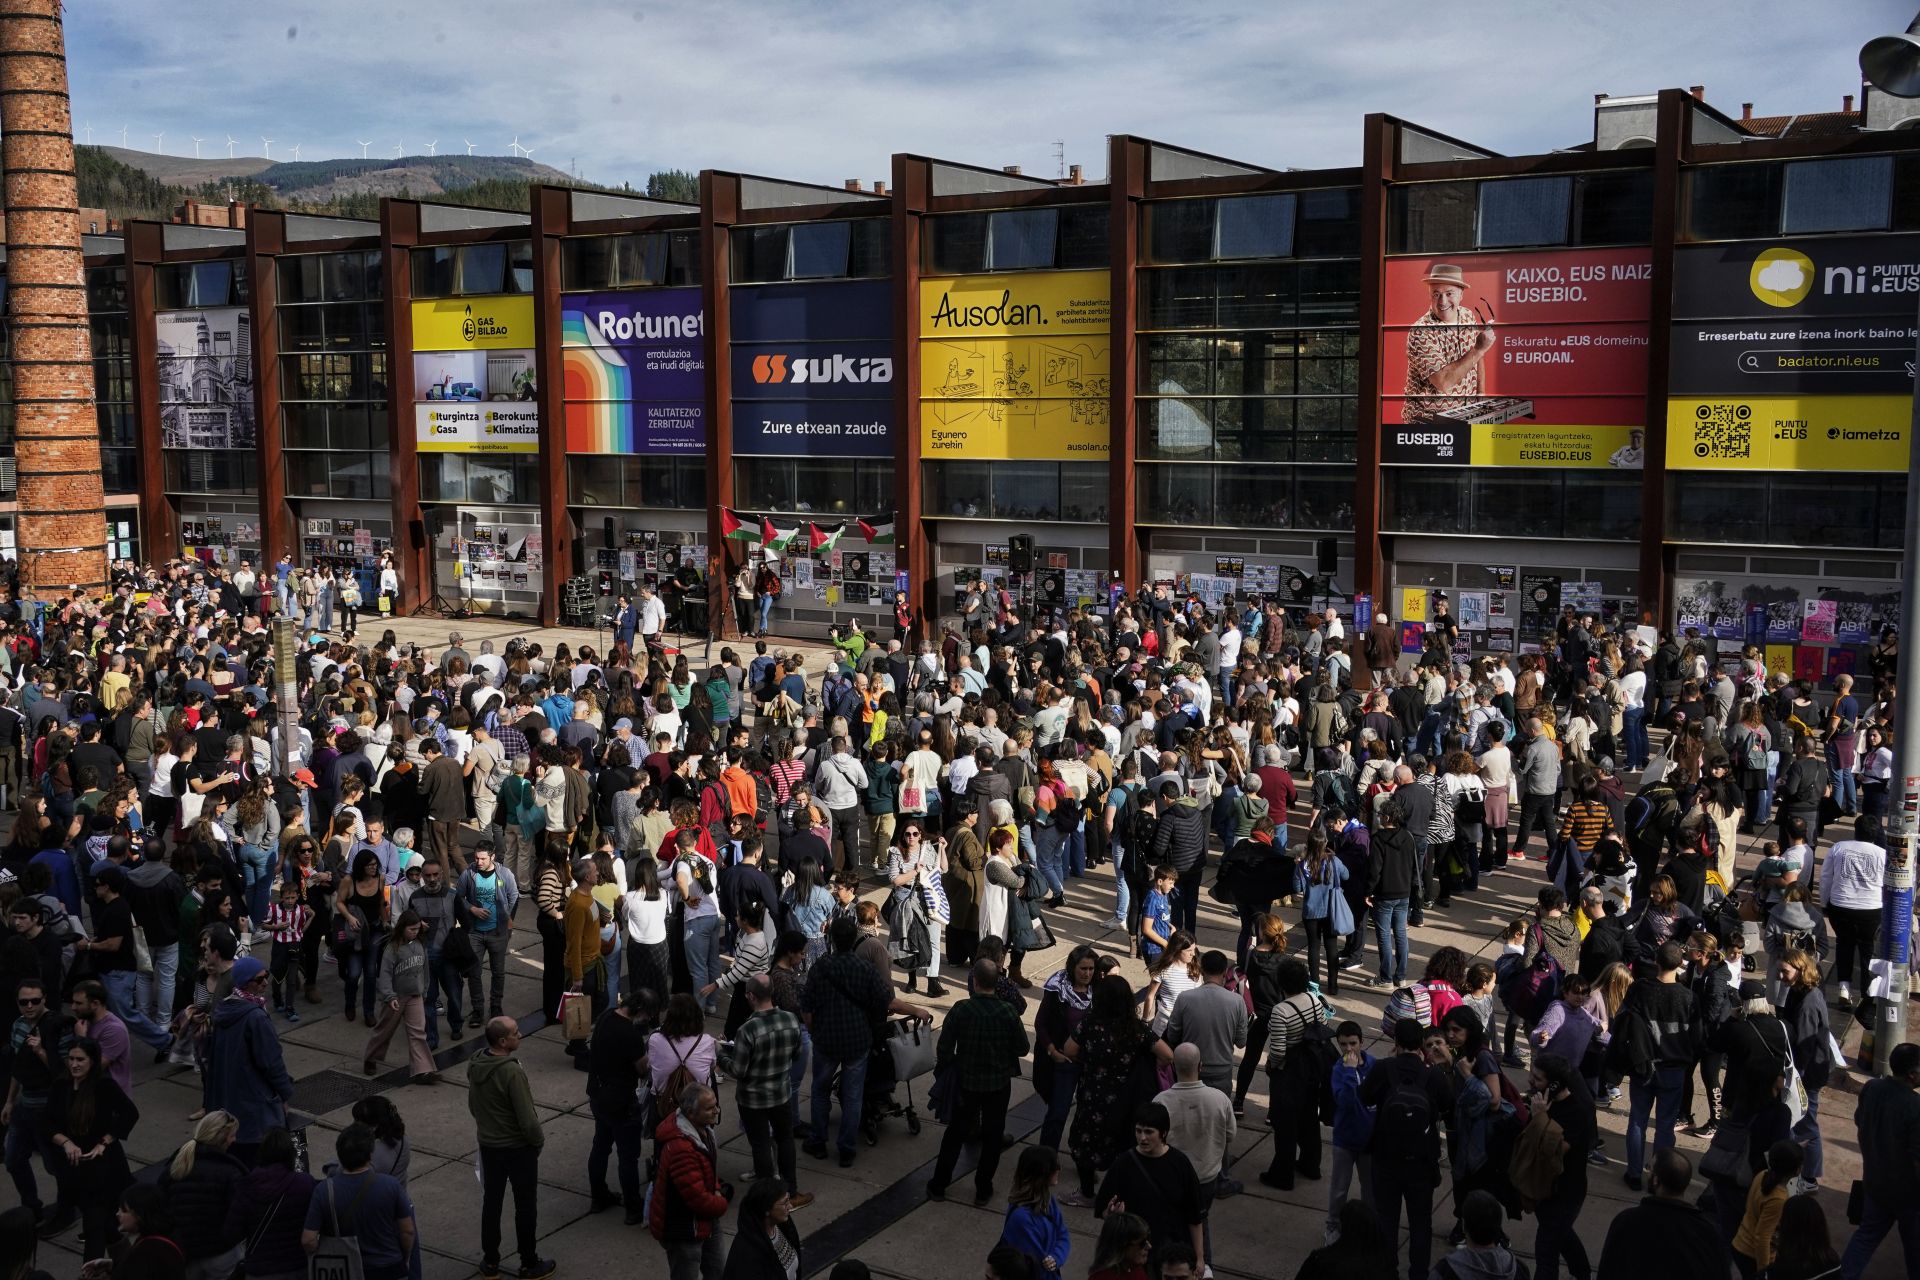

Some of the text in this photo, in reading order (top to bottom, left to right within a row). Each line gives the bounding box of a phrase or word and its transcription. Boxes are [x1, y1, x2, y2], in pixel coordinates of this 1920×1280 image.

[1506, 263, 1653, 285] KAIXO, EUS NAIZ
[1872, 263, 1920, 277] PUNTU
[1871, 277, 1920, 294] .EUS
[1505, 286, 1588, 304] EUSEBIO.
[931, 289, 1048, 328] Ausolan.
[477, 318, 494, 326] GAS
[477, 326, 508, 336] BILBAO
[1698, 331, 1768, 342] Erreserbatu
[1770, 332, 1797, 341] zure
[1798, 330, 1831, 340] izena
[1834, 329, 1866, 340] inork
[1869, 328, 1905, 339] baino
[1504, 334, 1649, 347] Eskuratu .EUS domeinu
[646, 348, 691, 359] errotulazioa
[1503, 352, 1575, 364] 9 EUROAN.
[646, 361, 658, 370] eta
[660, 359, 677, 370] irudi
[1778, 355, 1880, 368] badator.ni.eus
[436, 411, 480, 423] Iturgintza
[648, 408, 701, 418] KALITATEZKO
[436, 425, 458, 434] Gasa
[648, 419, 695, 429] ZERBITZUA!
[762, 420, 887, 434] Zure etxean zaude
[1774, 420, 1808, 429] PUNTU
[931, 429, 967, 441] Egunero
[1396, 432, 1454, 445] EUSEBIO
[1491, 431, 1594, 443] Erregistratzen laguntzeko,
[1774, 428, 1808, 440] .EUS
[1842, 428, 1901, 441] iametza
[931, 440, 963, 450] zurekin
[1523, 441, 1594, 450] eskatu hitzordua:
[1519, 450, 1593, 462] EUSEBIO.EUS
[1712, 1087, 1723, 1120] adidas
